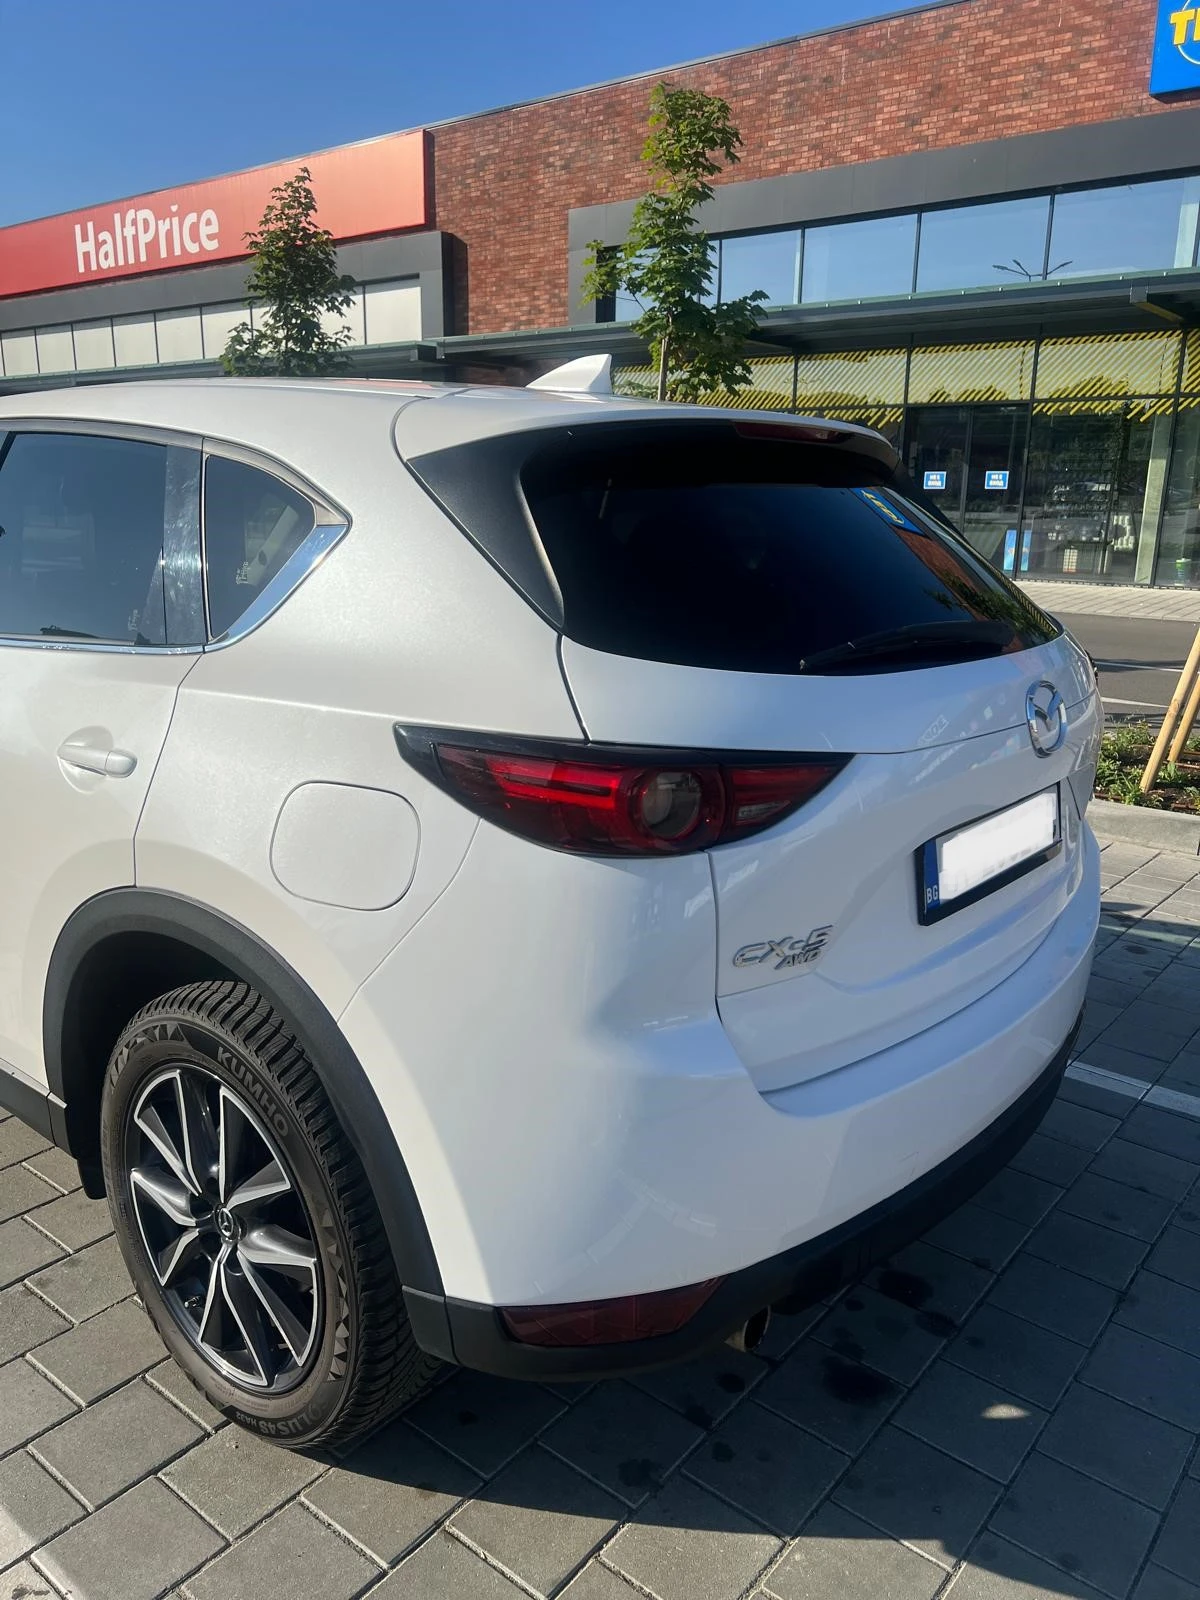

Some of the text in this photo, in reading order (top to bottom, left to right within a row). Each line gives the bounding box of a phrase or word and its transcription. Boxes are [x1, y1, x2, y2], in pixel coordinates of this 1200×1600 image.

[74, 204, 220, 274] HalfPrice
[926, 884, 938, 904] BG
[217, 1046, 289, 1137] KUMHO
